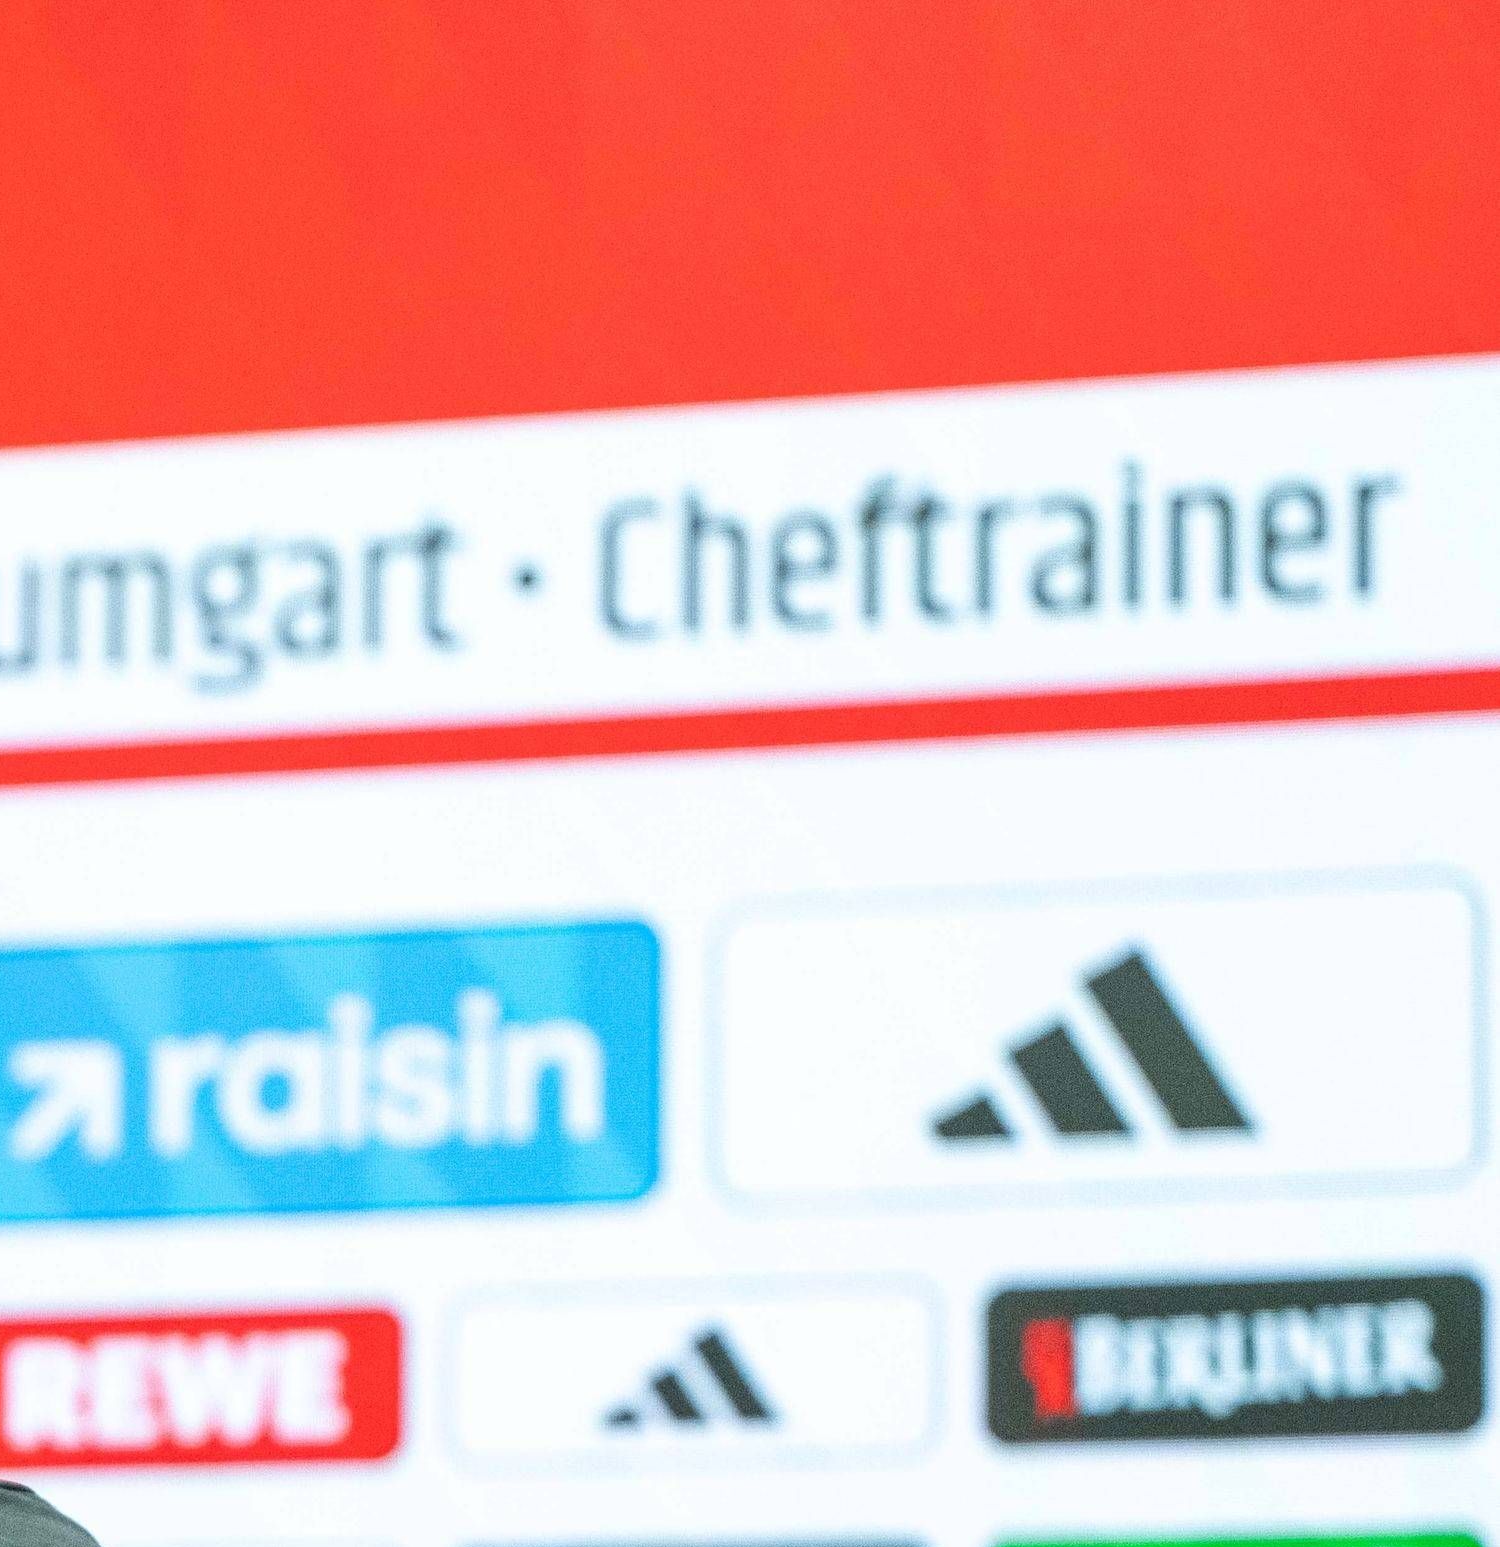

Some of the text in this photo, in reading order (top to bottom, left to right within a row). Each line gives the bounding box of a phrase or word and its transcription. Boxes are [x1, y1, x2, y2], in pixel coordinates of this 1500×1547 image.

[598, 466, 1400, 645] Cheftrainer
[151, 988, 604, 1158] raisin
[3, 1330, 352, 1451] REWE
[1076, 1296, 1444, 1418] BERLINER
